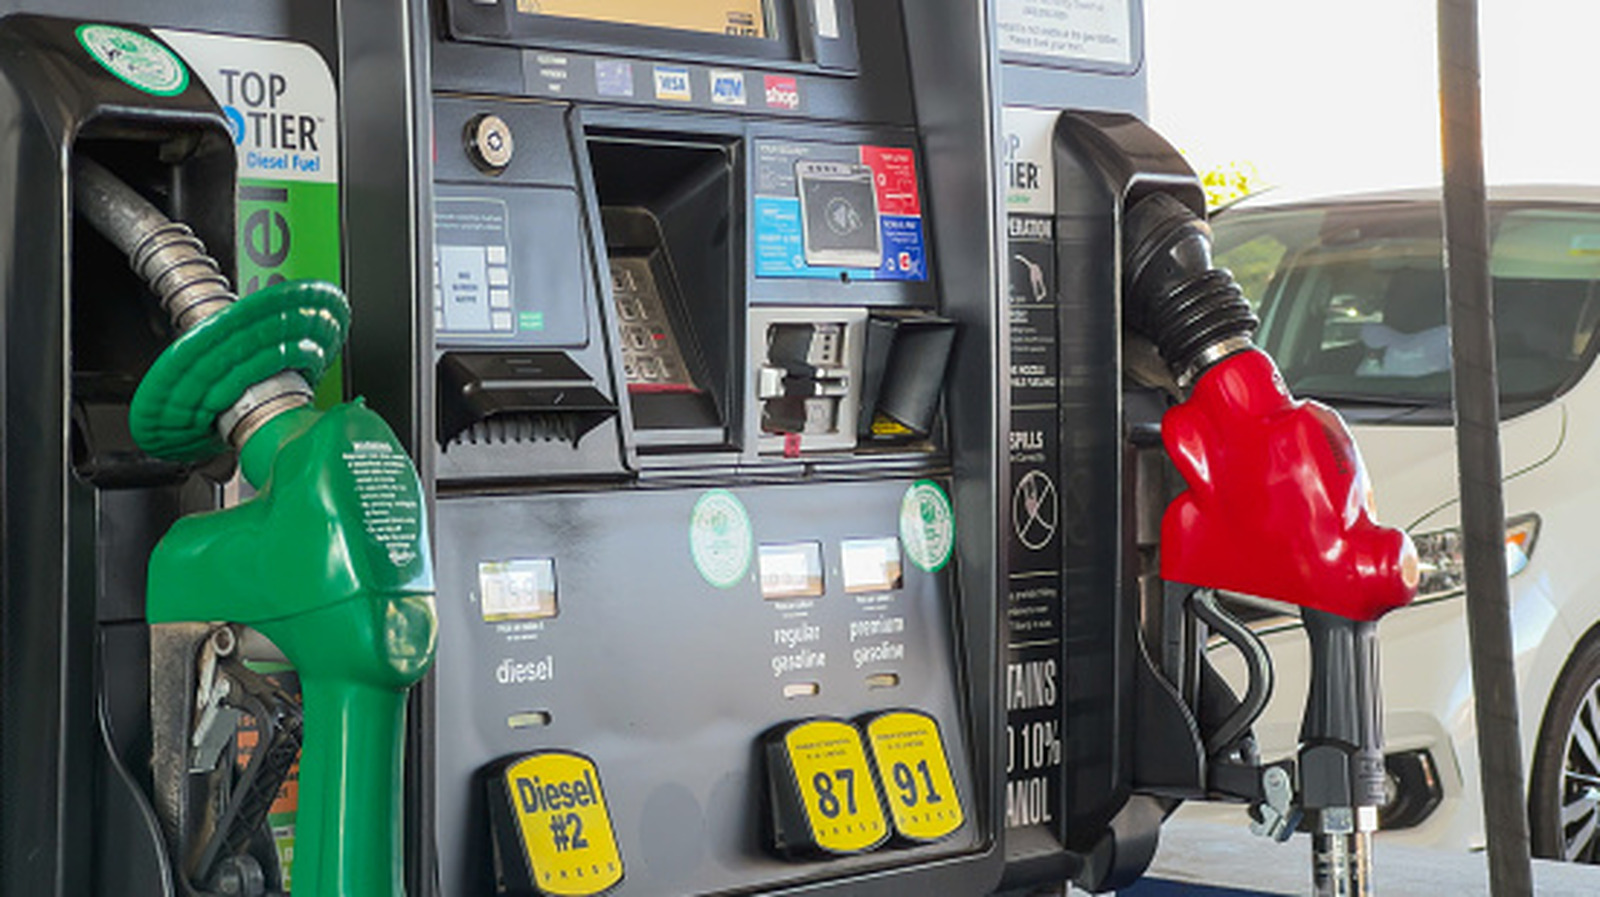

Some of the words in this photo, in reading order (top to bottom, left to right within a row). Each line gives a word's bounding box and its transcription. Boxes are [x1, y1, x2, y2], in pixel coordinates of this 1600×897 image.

[219, 69, 286, 108] TOP
[765, 86, 800, 109] shop
[246, 112, 319, 152] TIER
[246, 152, 288, 169] Diesel
[292, 154, 320, 172] Fuel
[774, 622, 820, 649] regular
[496, 655, 553, 684] diesel
[1022, 719, 1062, 770] 10%
[516, 769, 598, 813] Diesel
[812, 769, 858, 819] 87
[893, 759, 942, 807] 91
[549, 813, 589, 852] #2
